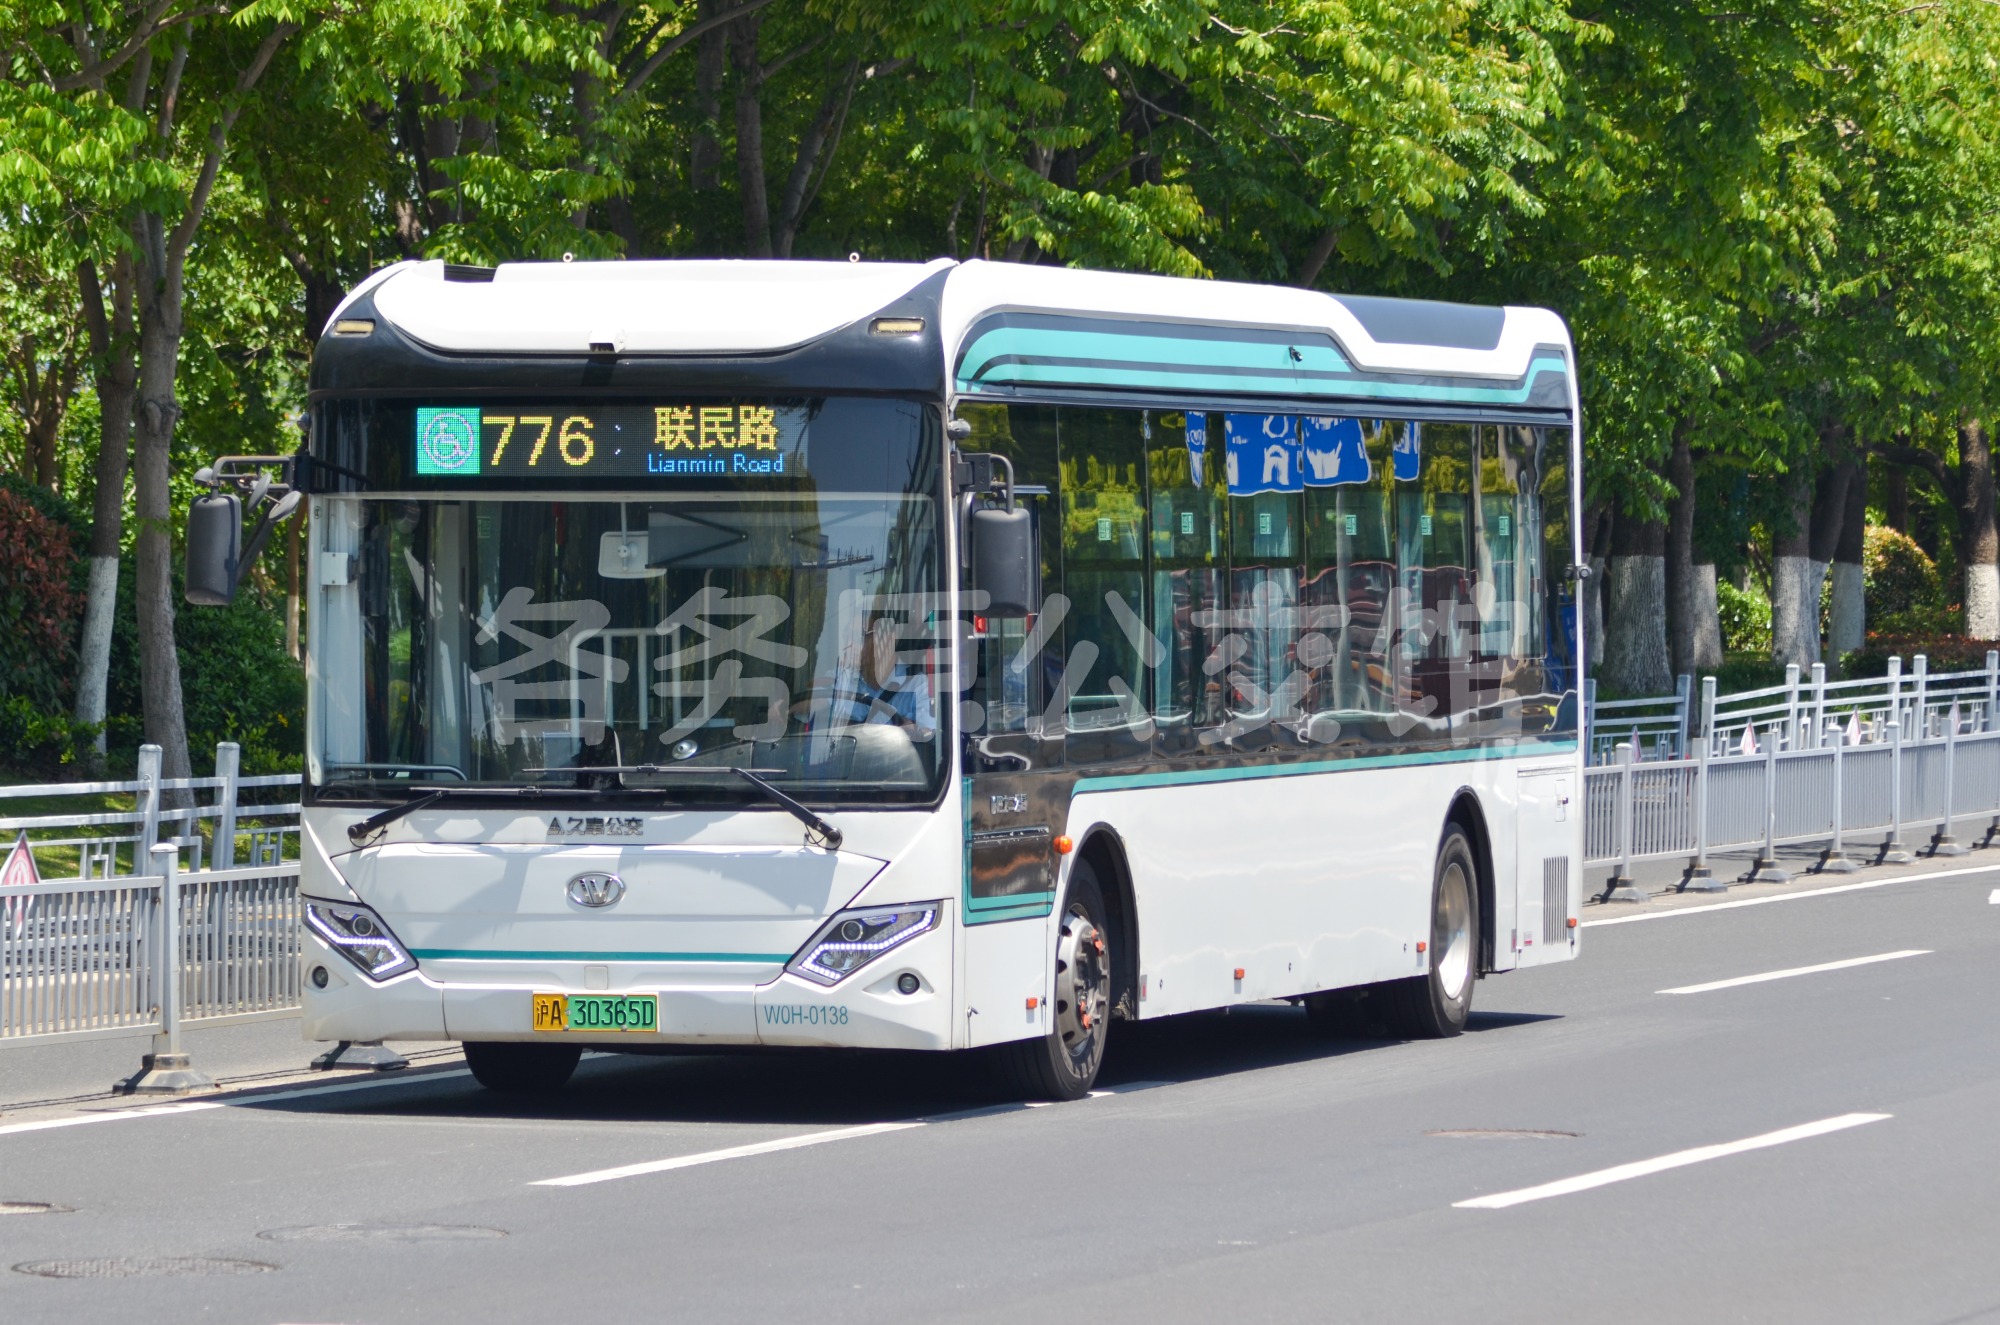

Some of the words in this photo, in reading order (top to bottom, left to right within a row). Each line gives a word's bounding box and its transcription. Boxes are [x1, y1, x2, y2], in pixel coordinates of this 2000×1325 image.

[483, 416, 594, 466] 776
[655, 405, 778, 450] 联民路
[648, 453, 725, 472] Lianmin
[733, 453, 783, 472] Road
[566, 816, 644, 836] 久事公交
